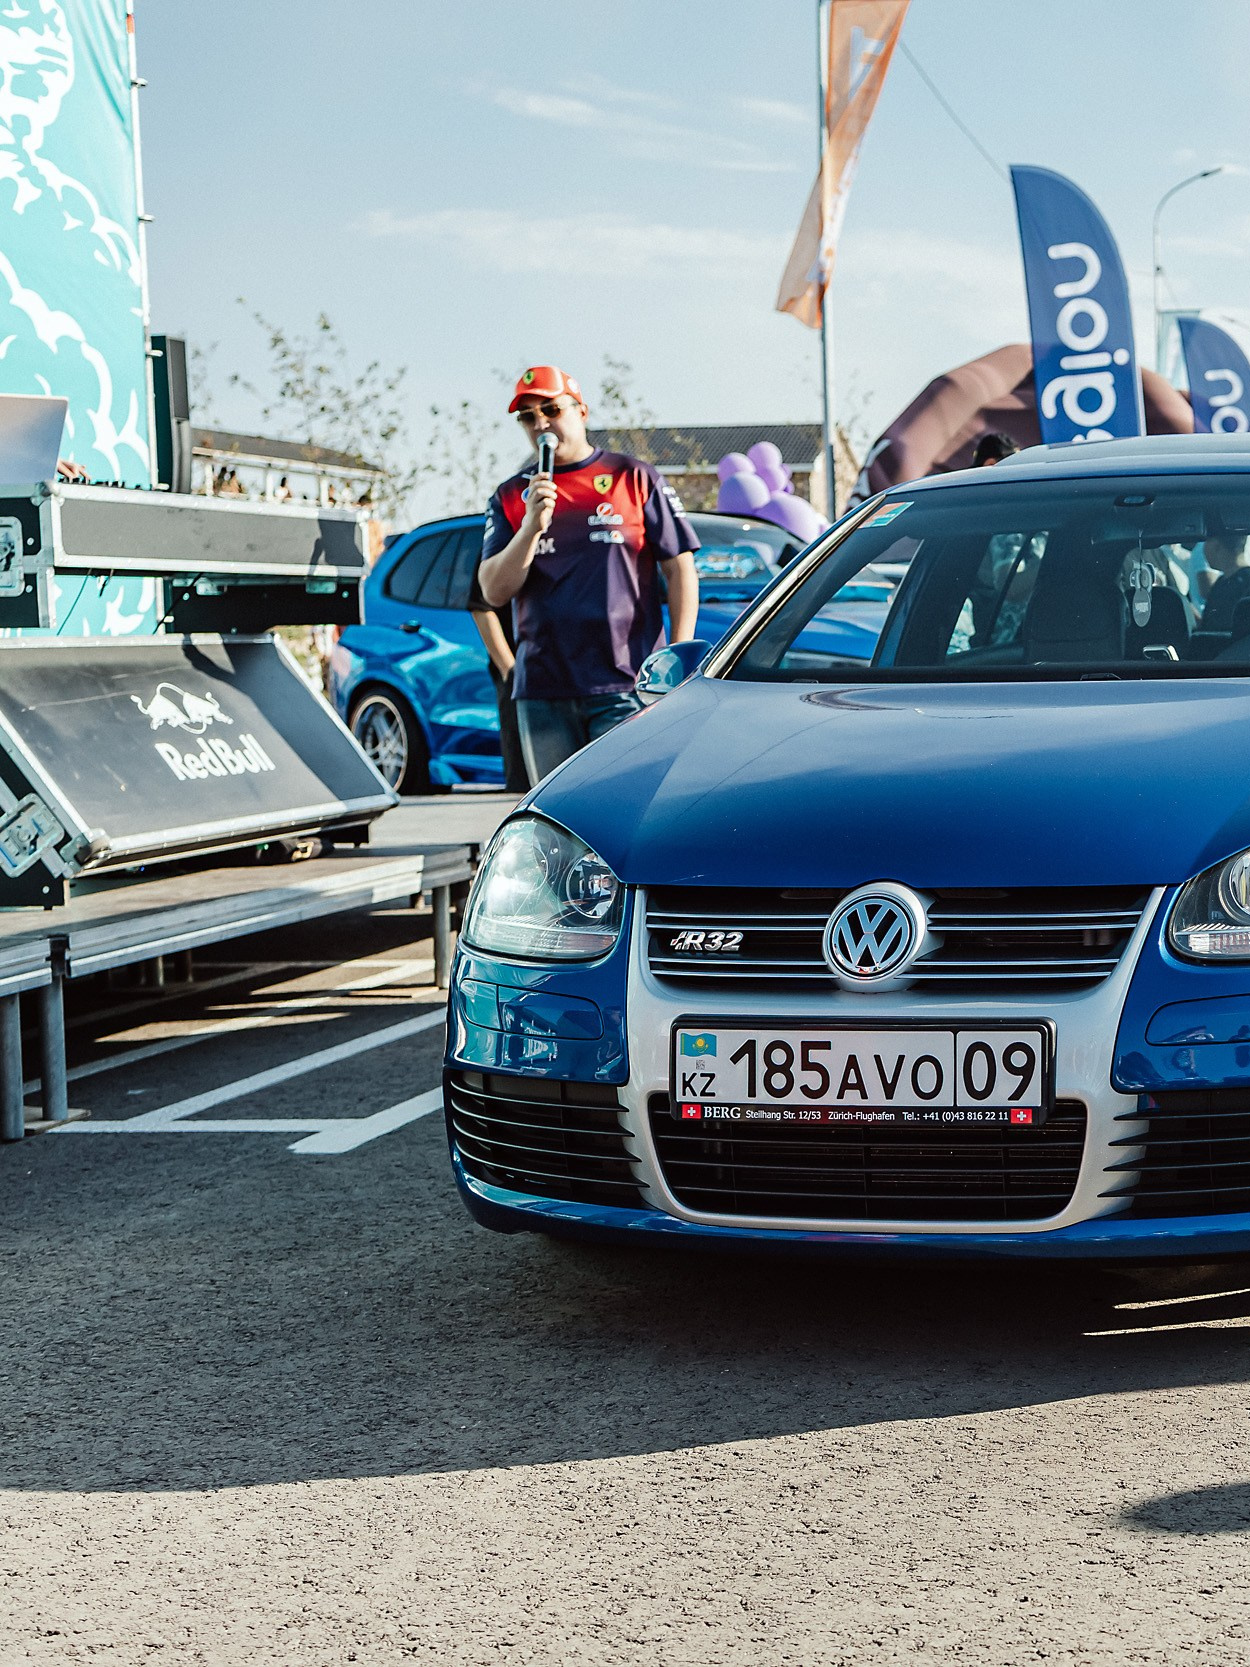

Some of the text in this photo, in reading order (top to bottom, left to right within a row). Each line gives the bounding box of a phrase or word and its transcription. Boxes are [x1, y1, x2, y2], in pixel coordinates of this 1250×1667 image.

[682, 931, 744, 951] R32
[834, 900, 911, 972] VW
[962, 1041, 1036, 1101] 09
[681, 1072, 716, 1097] KZ
[703, 1106, 1009, 1122] BERG Steilhang Str. 12/53 Zürich-Flughafen Tel.: +41 (0)43 816 22 11
